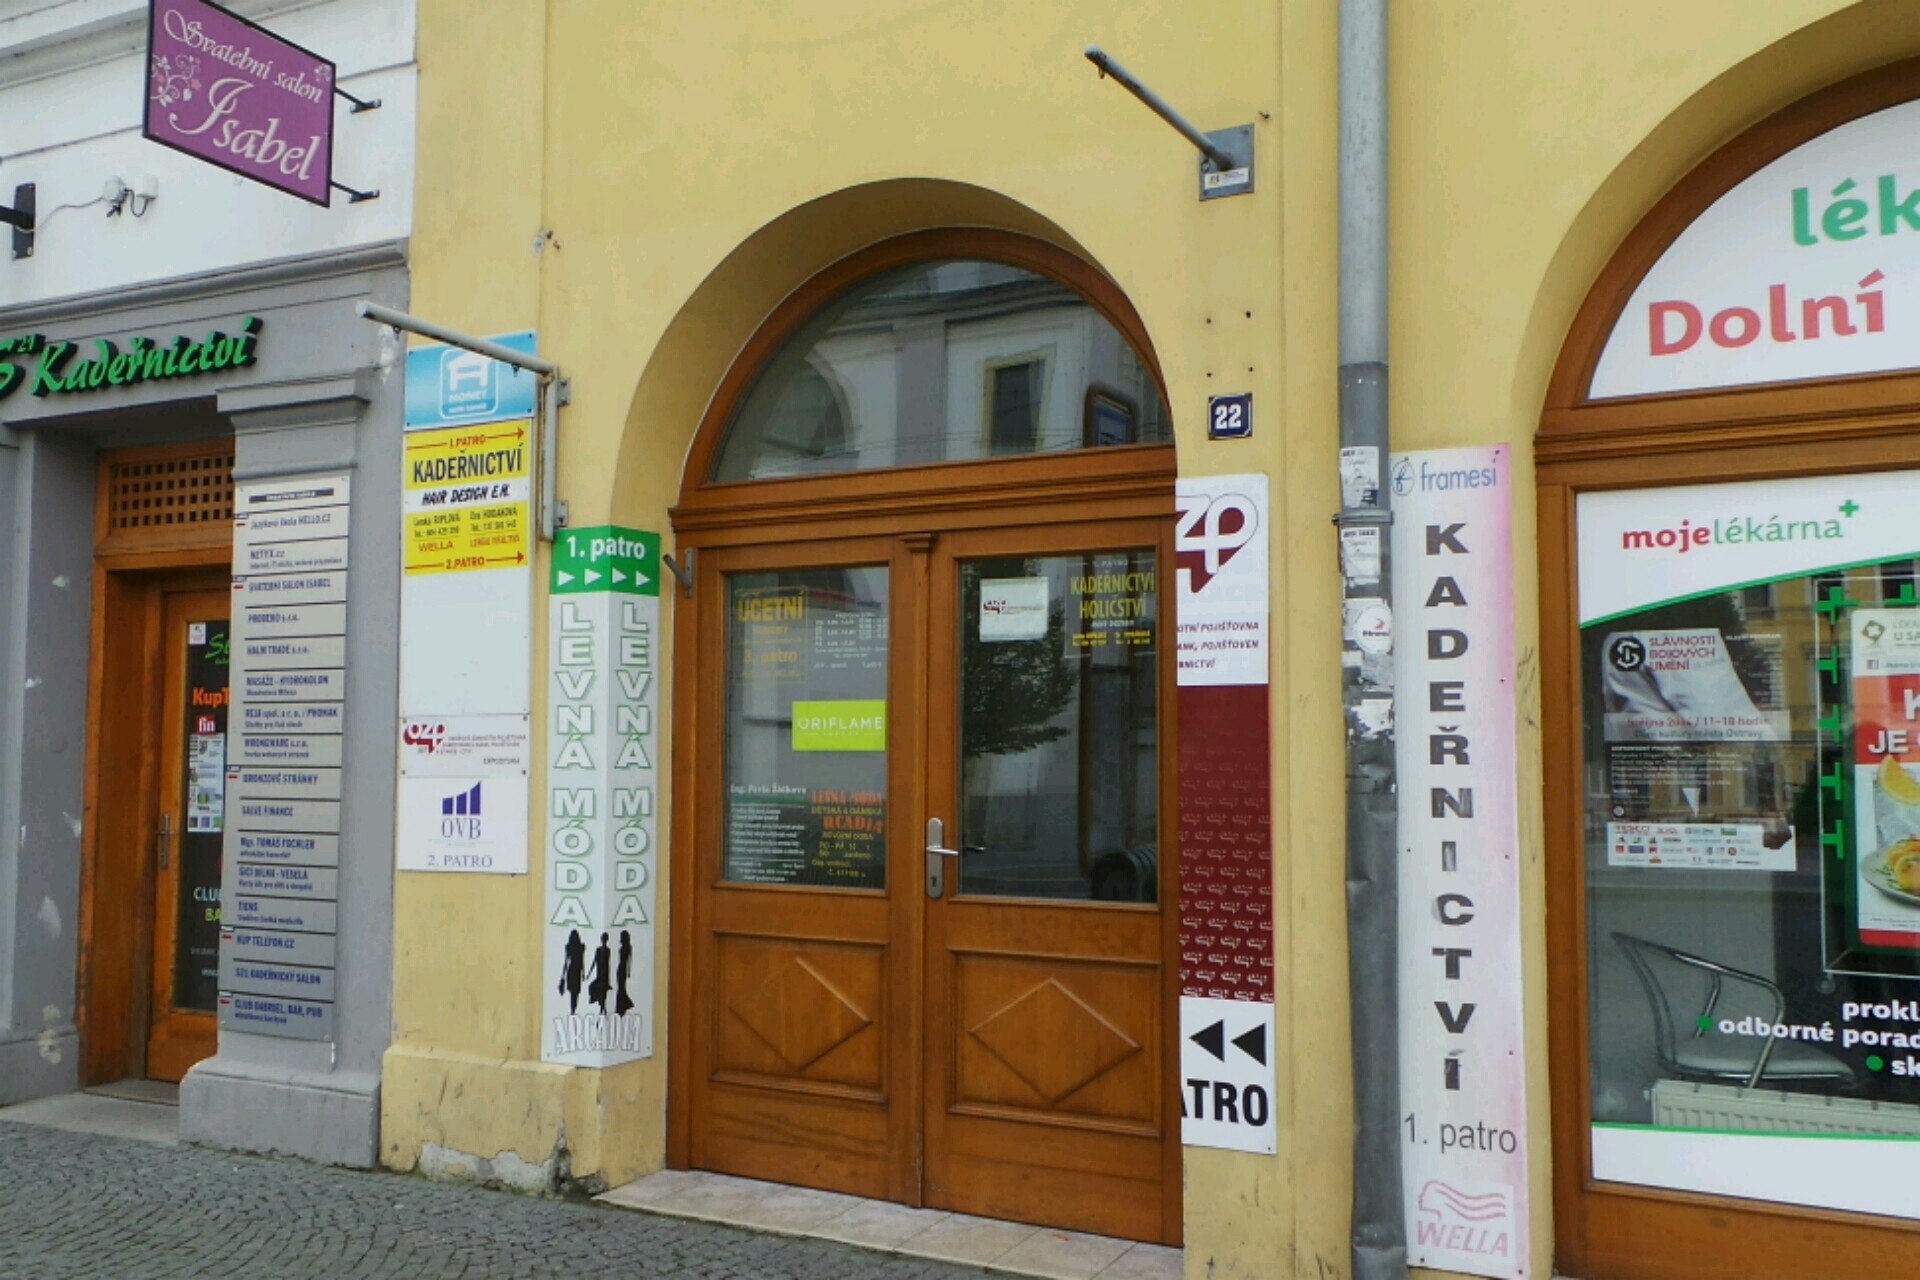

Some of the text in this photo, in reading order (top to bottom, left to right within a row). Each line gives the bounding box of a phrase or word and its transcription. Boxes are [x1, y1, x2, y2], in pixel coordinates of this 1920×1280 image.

[274, 71, 323, 103] salon
[169, 77, 321, 181] Isabel
[1649, 268, 1886, 357] Dolní
[31, 315, 262, 397] Kadeřnictví
[1214, 403, 1242, 430] 22
[413, 442, 525, 483] KADEŘNICTVÍ
[1420, 458, 1497, 492] framesi
[566, 535, 647, 562] 1. patro
[1622, 514, 1844, 553] mojelékárna
[1070, 566, 1156, 596] KADEŘNICTVÍ
[1079, 592, 1147, 620] HOLIČSTVÍ
[1648, 634, 1716, 647] SLAVNOSTI
[553, 601, 597, 770] LEVNÁ
[613, 601, 654, 769] LEVNÁ
[798, 715, 883, 731] ORIFLAME
[1868, 729, 1909, 754] JE
[1424, 522, 1478, 1091] KADEŘNICTVÍ
[441, 816, 482, 841] OVB
[444, 854, 493, 868] PATRO
[550, 787, 597, 929] MÓDA
[611, 787, 653, 928] MÓDA
[1718, 1016, 1834, 1042] odborné
[1440, 1120, 1518, 1154] patro
[1417, 1220, 1509, 1257] WELLA
